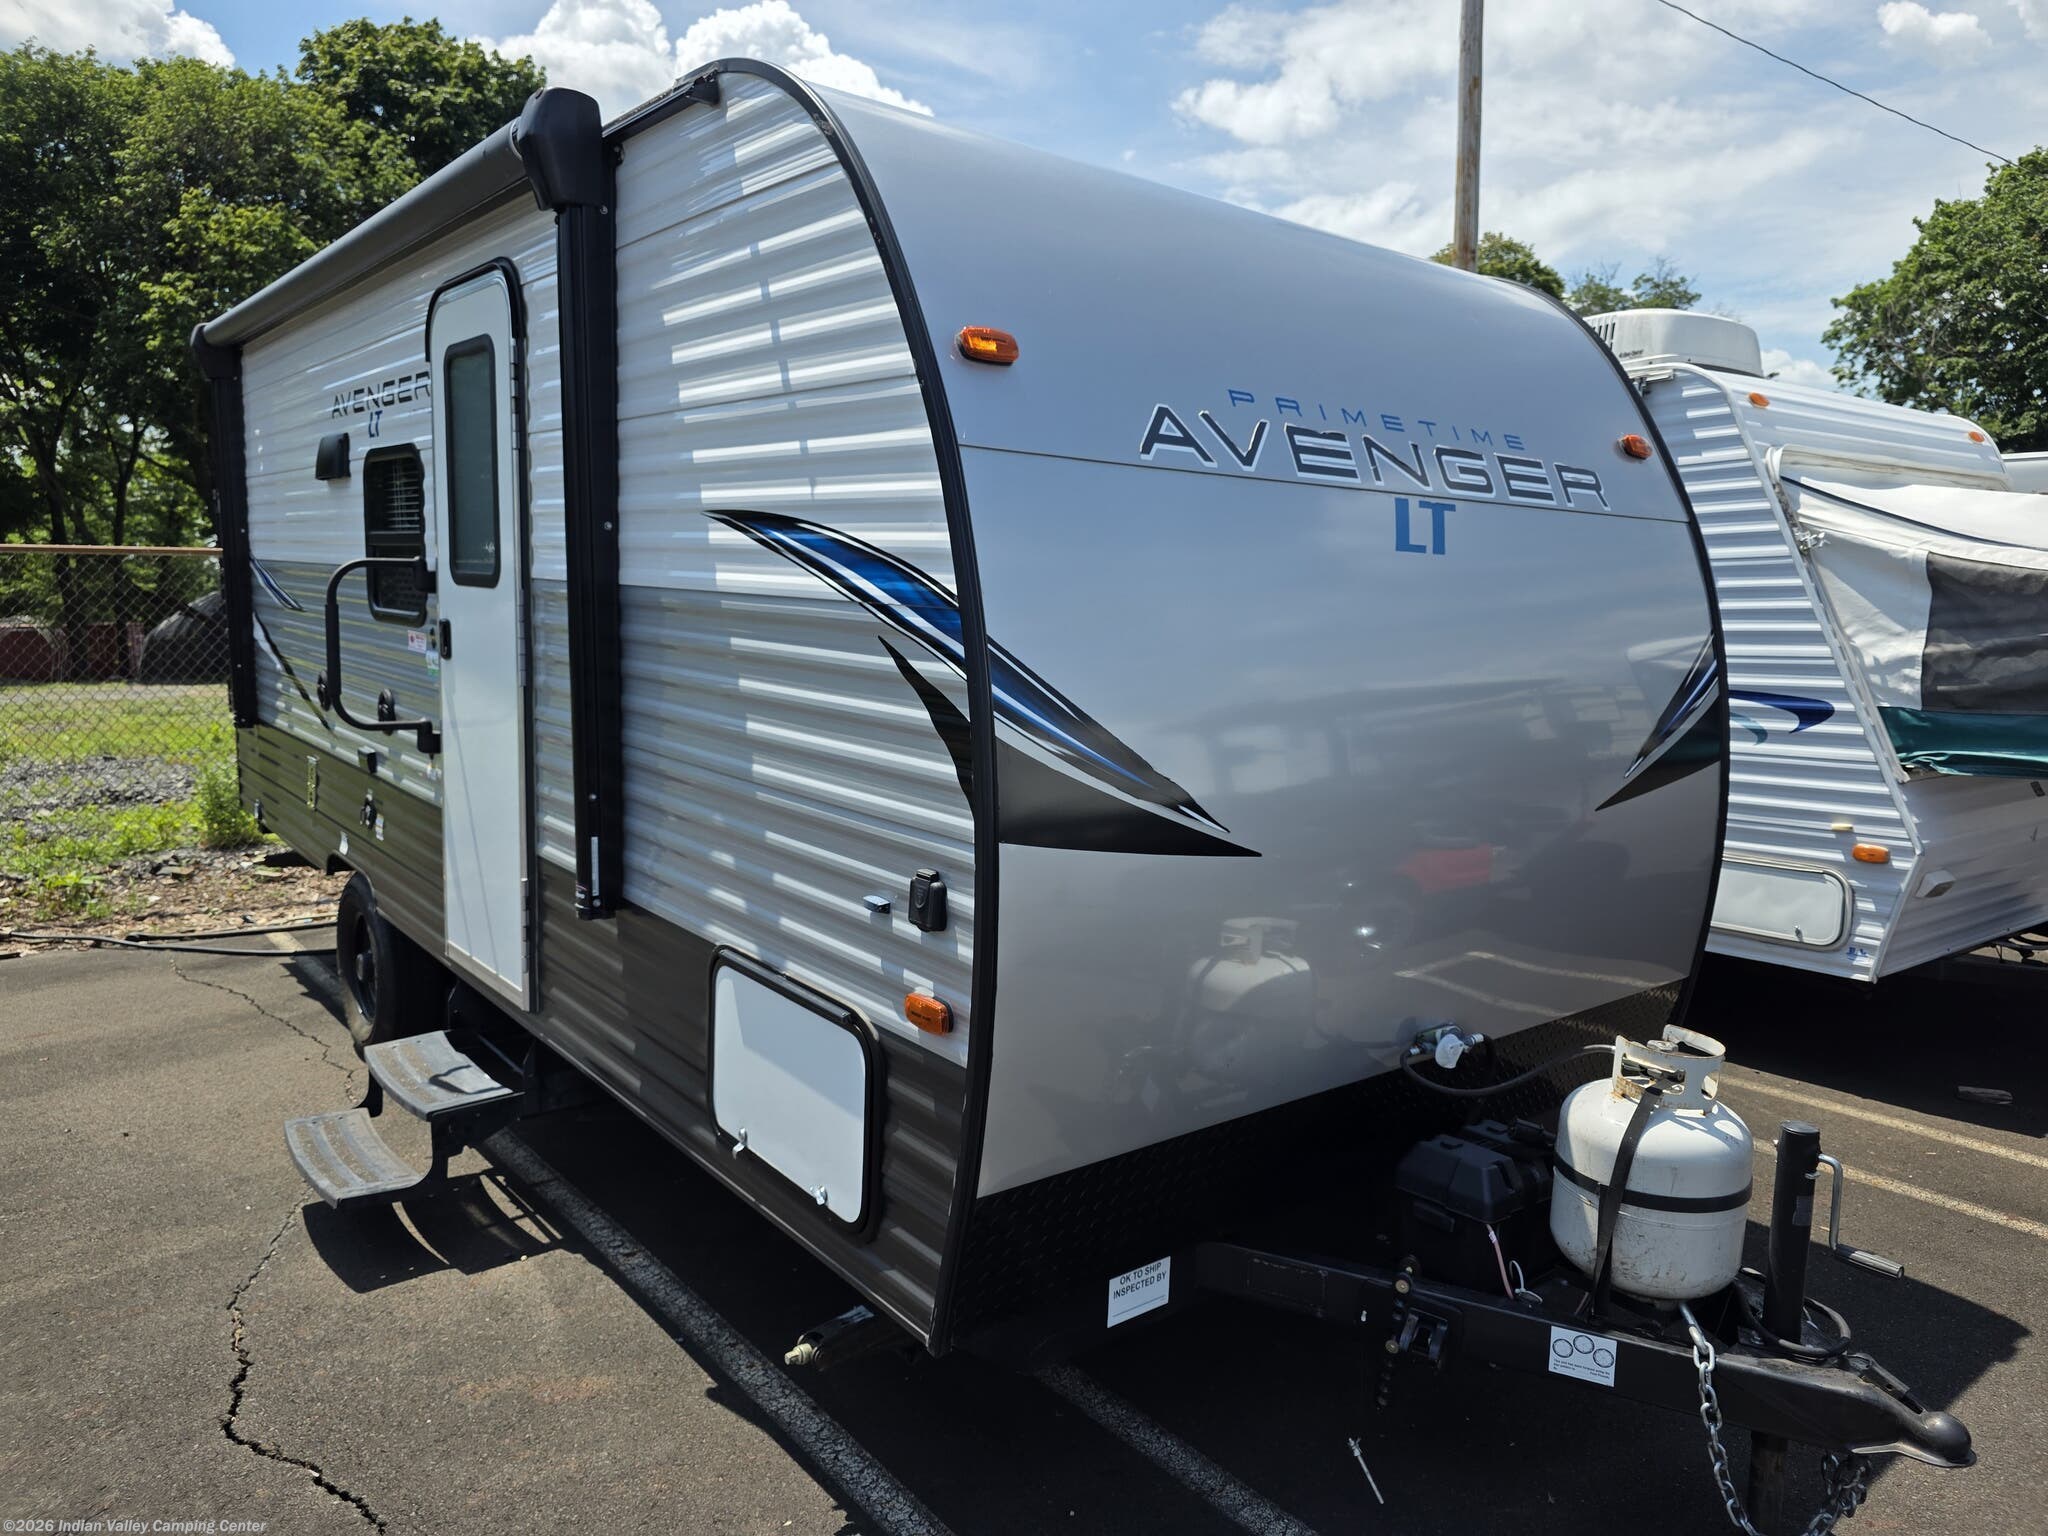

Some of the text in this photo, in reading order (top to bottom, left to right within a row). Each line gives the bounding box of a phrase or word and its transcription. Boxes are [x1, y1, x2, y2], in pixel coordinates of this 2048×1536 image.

[331, 371, 431, 419] AVENGER
[368, 410, 383, 439] LT
[1227, 388, 1527, 452] PRIMETIME
[1138, 402, 1612, 512] AVENGER
[1394, 497, 1457, 556] LT
[1113, 1270, 1167, 1300] INSPECTED BY
[1120, 1262, 1162, 1286] OK TO SHIP
